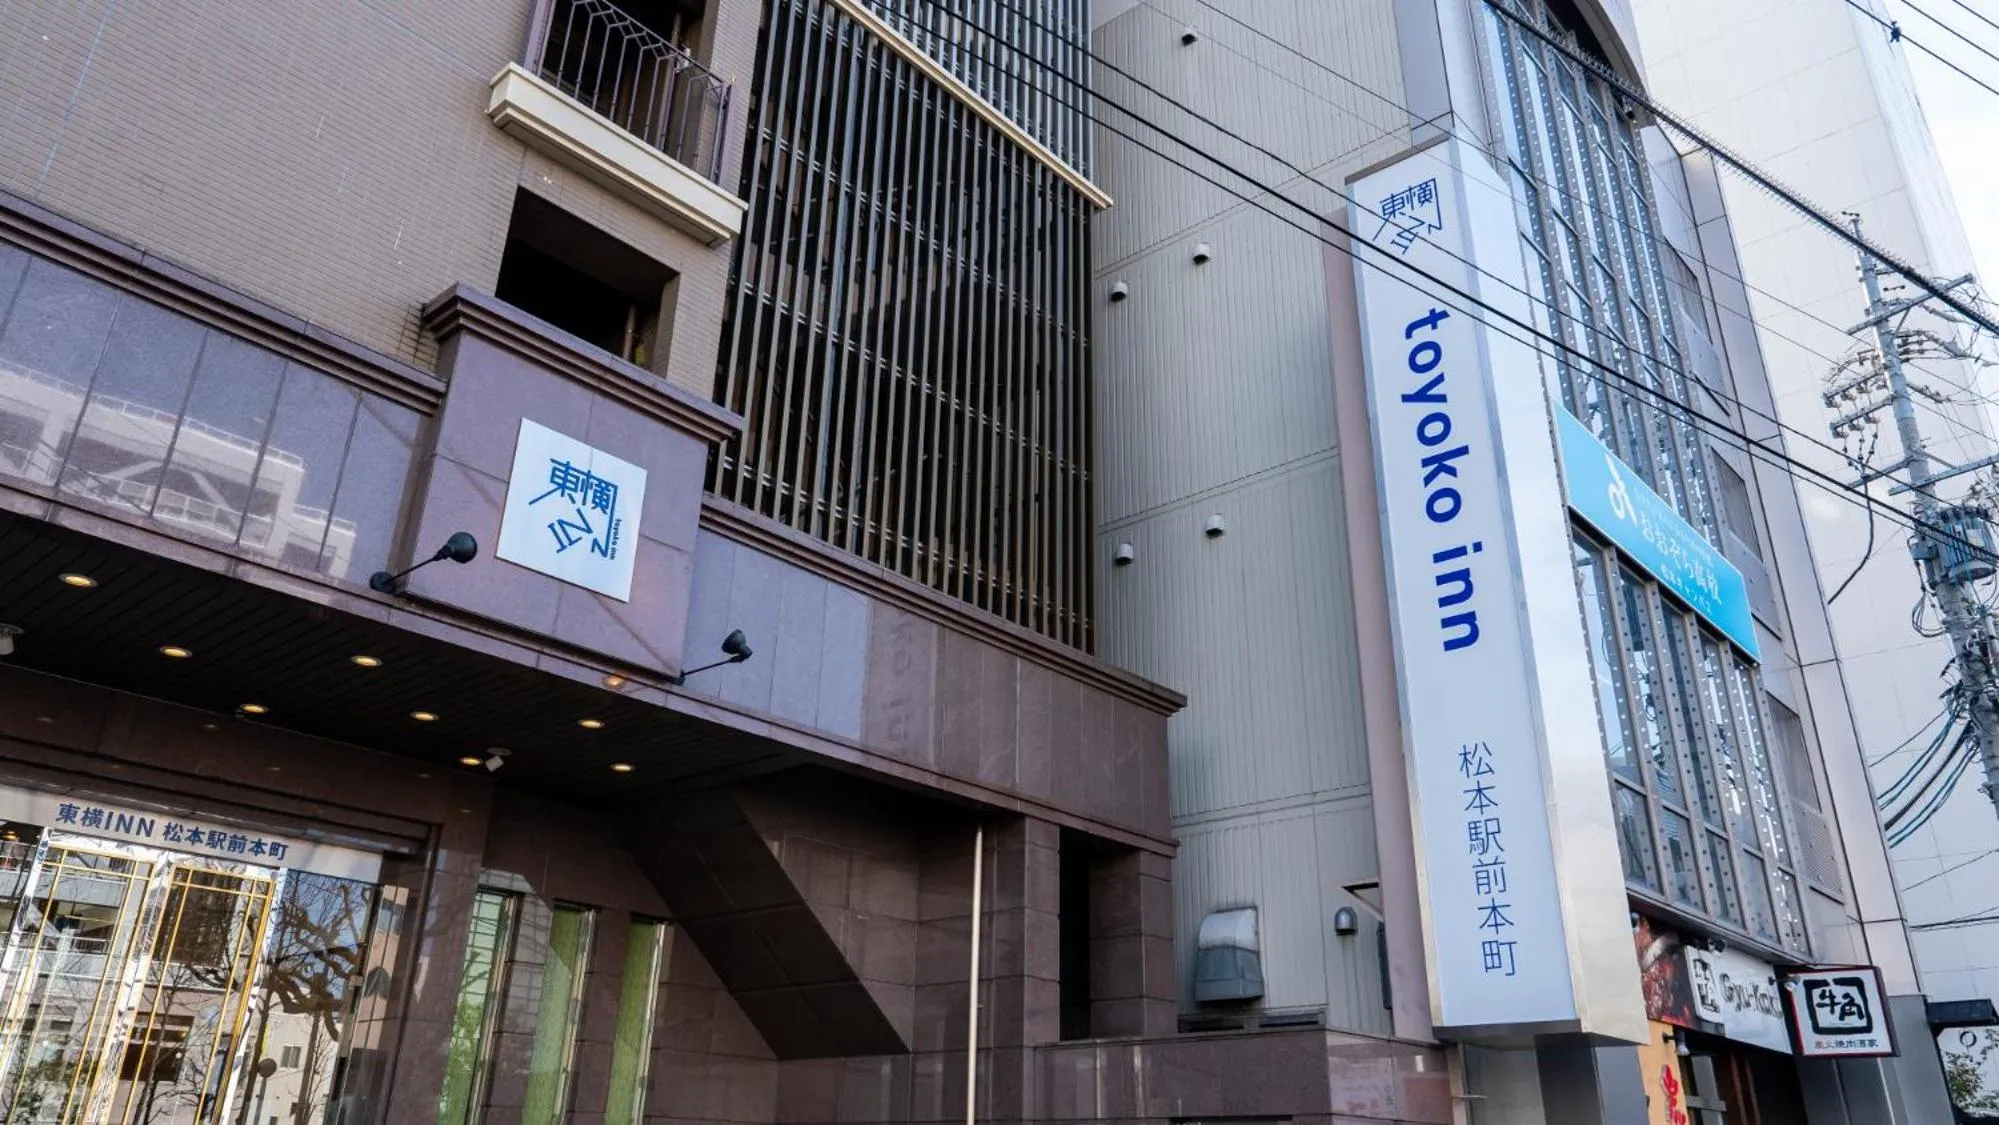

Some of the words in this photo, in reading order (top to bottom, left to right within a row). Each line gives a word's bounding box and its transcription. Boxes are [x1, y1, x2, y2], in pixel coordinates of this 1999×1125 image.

[1401, 308, 1470, 523] toyoko
[1432, 541, 1483, 652] inn
[56, 803, 156, 838] 東横INN
[162, 821, 289, 861] 松本駅前本町
[1458, 741, 1519, 977] 松本駅前本町
[1815, 988, 1865, 1022] 牛角
